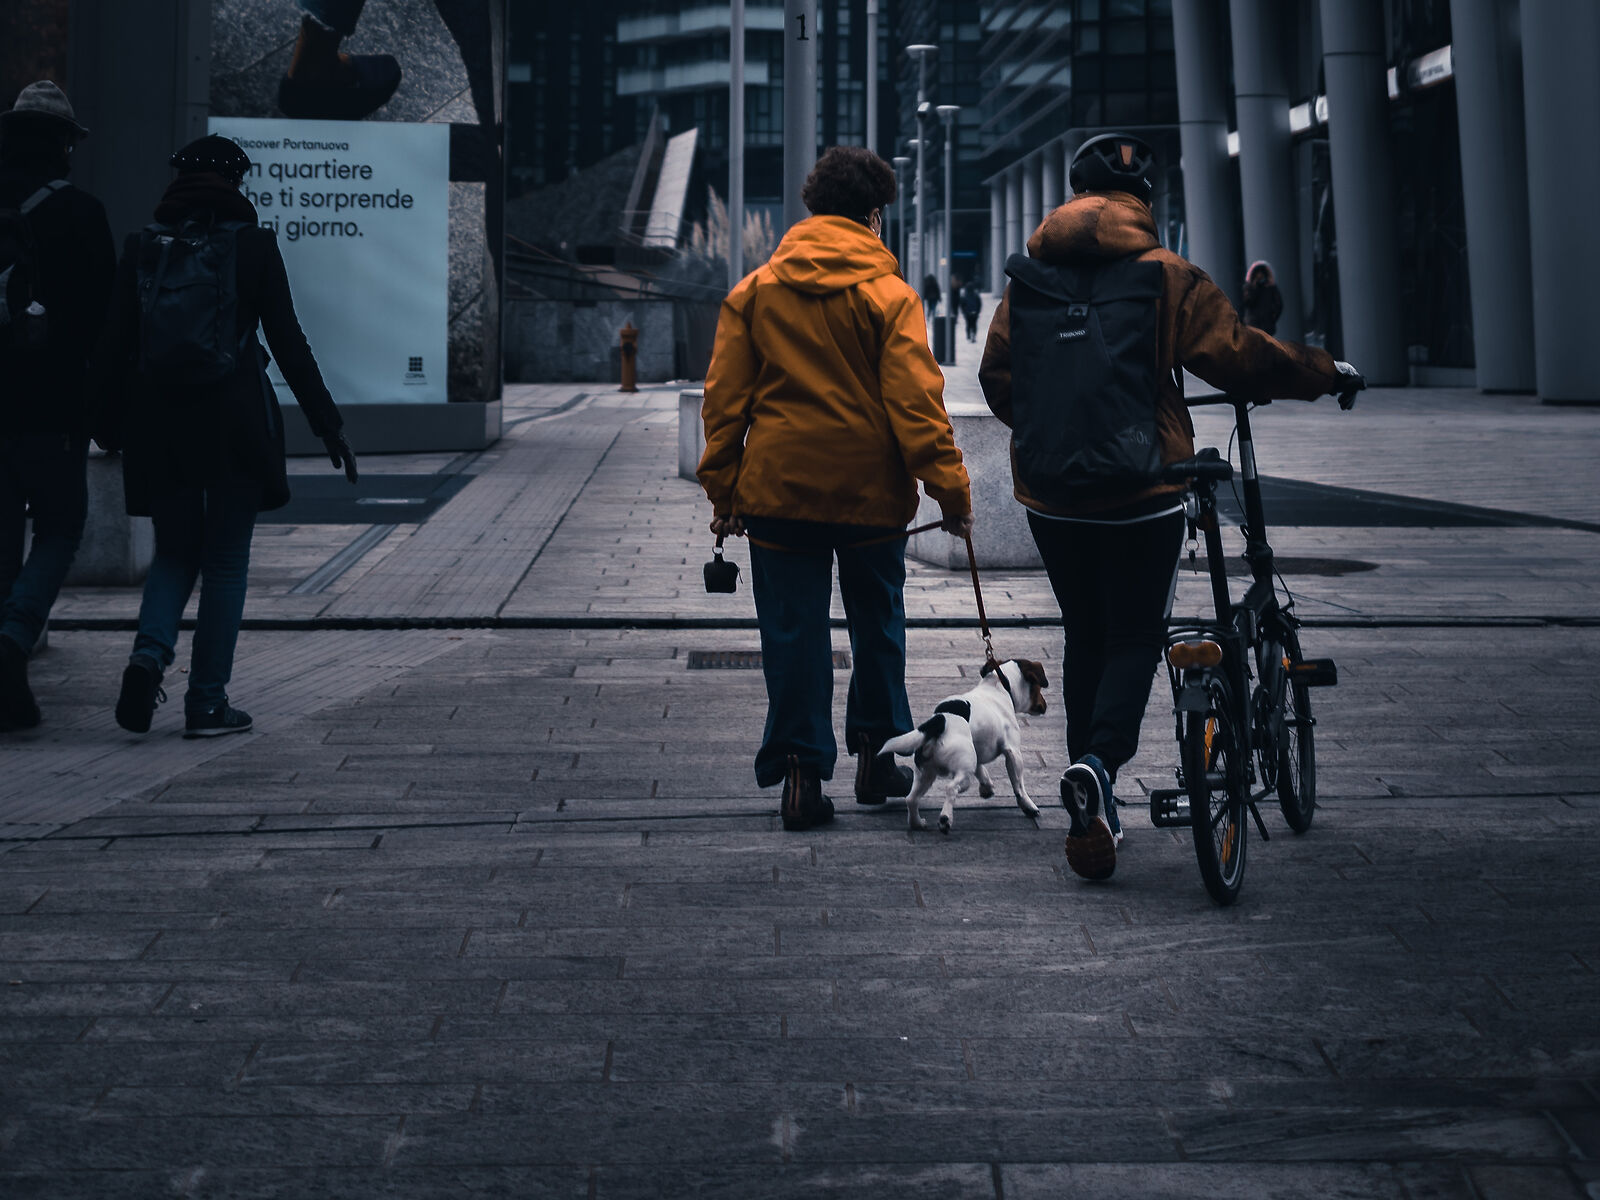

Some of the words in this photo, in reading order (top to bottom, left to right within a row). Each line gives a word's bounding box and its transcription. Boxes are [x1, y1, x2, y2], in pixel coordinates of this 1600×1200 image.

[796, 14, 809, 41] 1
[283, 138, 349, 151] Portanuova
[268, 159, 372, 182] quartiere
[246, 186, 273, 207] he
[279, 186, 294, 207] ti
[300, 188, 413, 212] sorprende
[286, 215, 363, 241] giorno.
